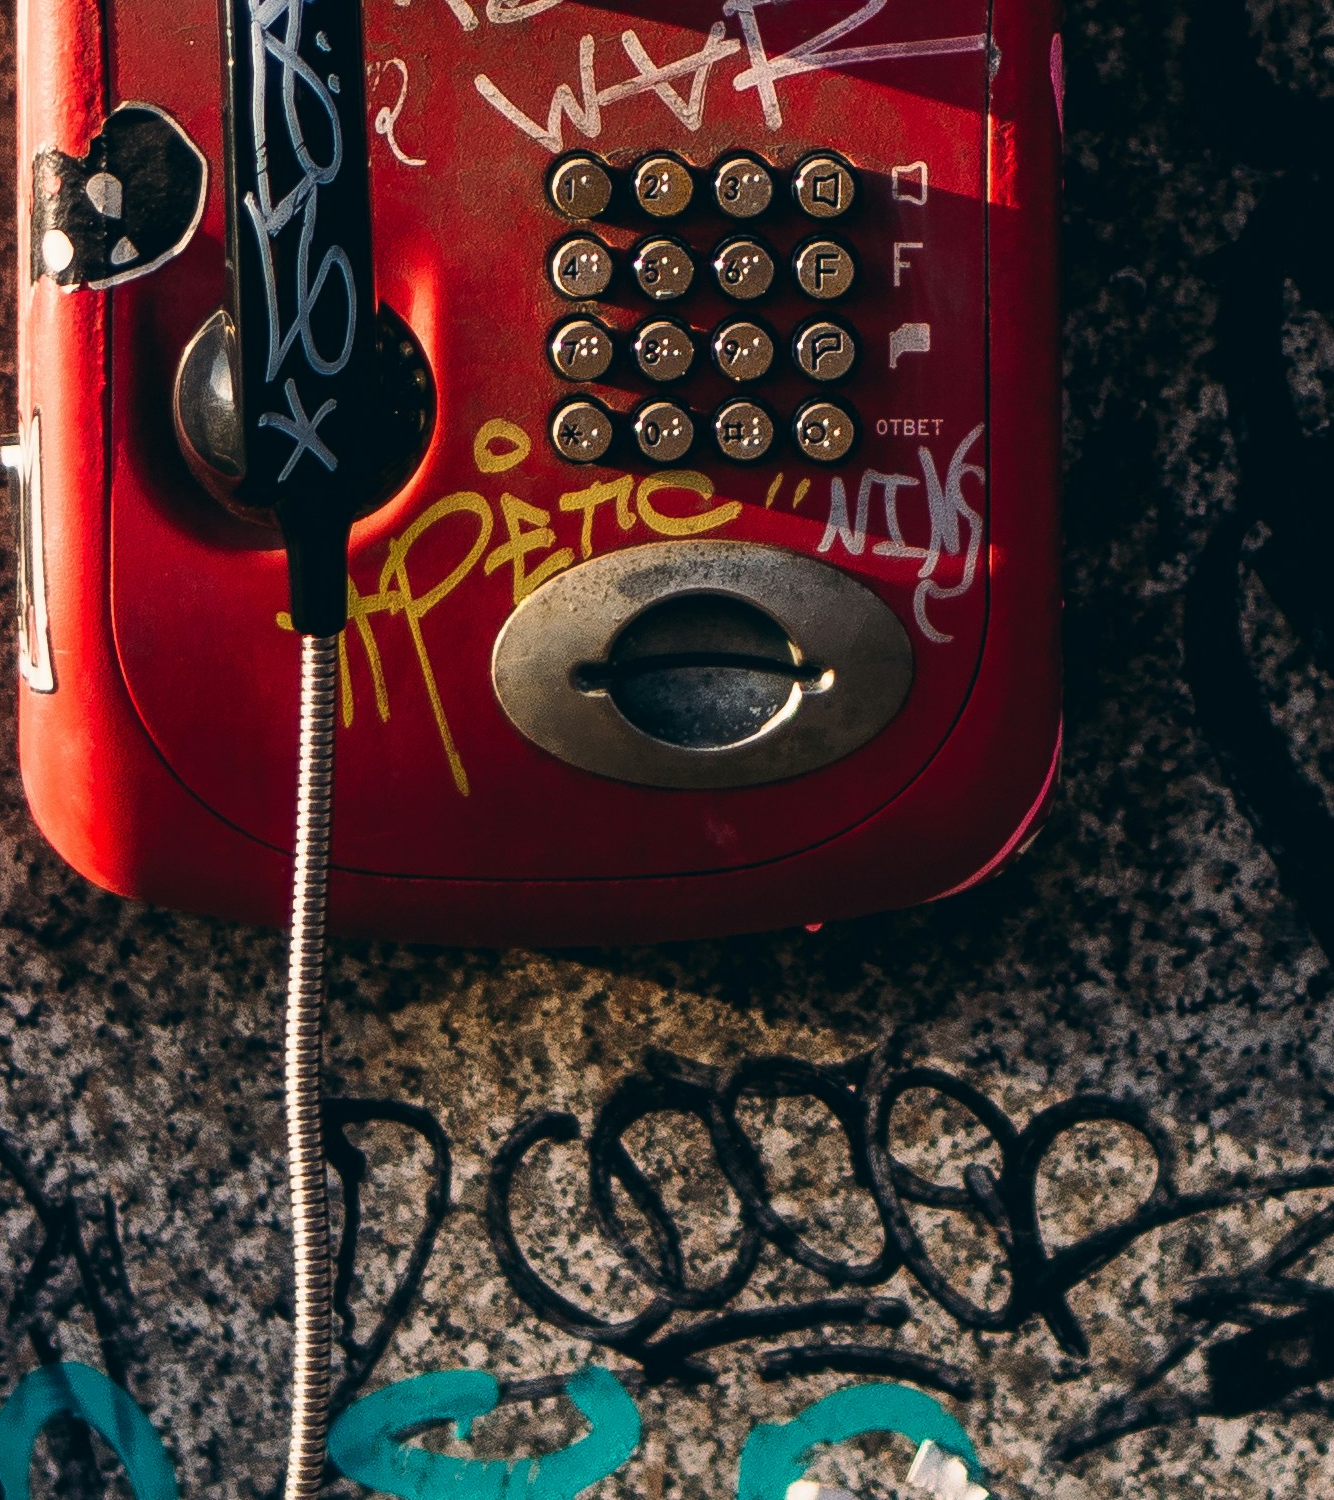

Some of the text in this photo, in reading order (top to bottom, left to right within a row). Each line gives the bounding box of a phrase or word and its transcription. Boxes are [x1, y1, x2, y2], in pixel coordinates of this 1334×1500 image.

[643, 175, 661, 201] 2
[723, 176, 740, 201] 3
[562, 256, 579, 282] 4
[644, 258, 660, 284] 5
[724, 259, 743, 284] 6
[813, 252, 841, 291] F
[892, 241, 925, 288] F
[564, 340, 581, 366] 7
[643, 339, 661, 366] 8
[724, 339, 741, 366] 9
[644, 421, 661, 448] 0
[875, 417, 945, 437] ОТВЕТ
